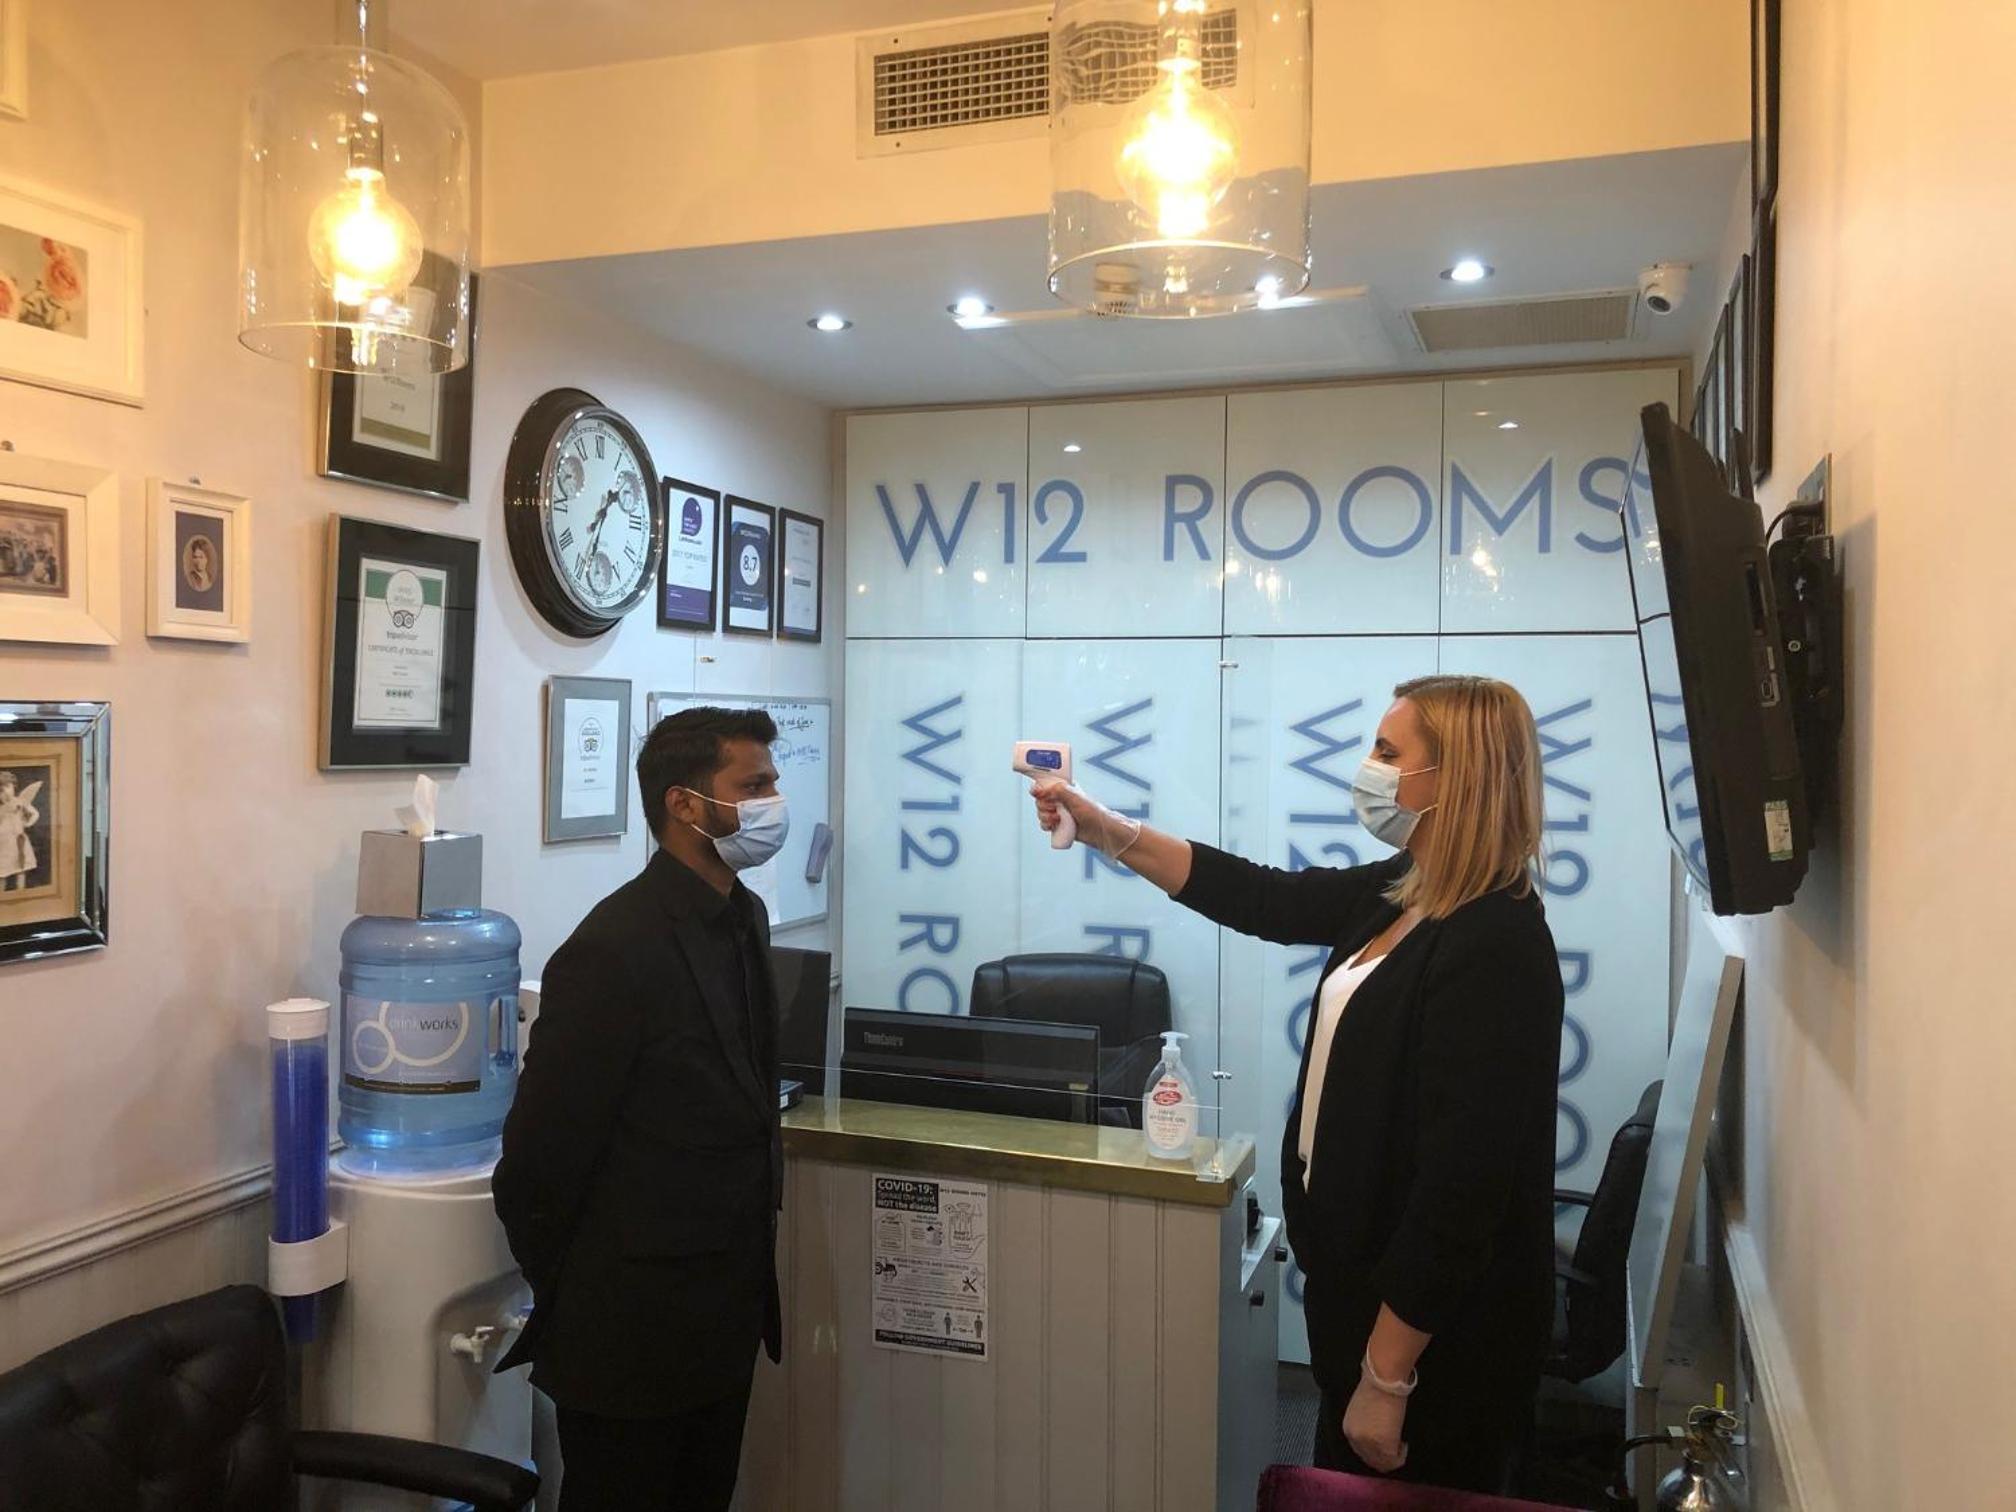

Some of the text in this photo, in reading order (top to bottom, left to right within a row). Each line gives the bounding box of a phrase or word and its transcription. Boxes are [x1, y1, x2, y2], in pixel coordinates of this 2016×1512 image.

[875, 457, 1629, 569] W12 ROOMS
[743, 555, 758, 572] 8.7
[900, 695, 963, 870] W12
[878, 1180, 934, 1194] COVID-19:
